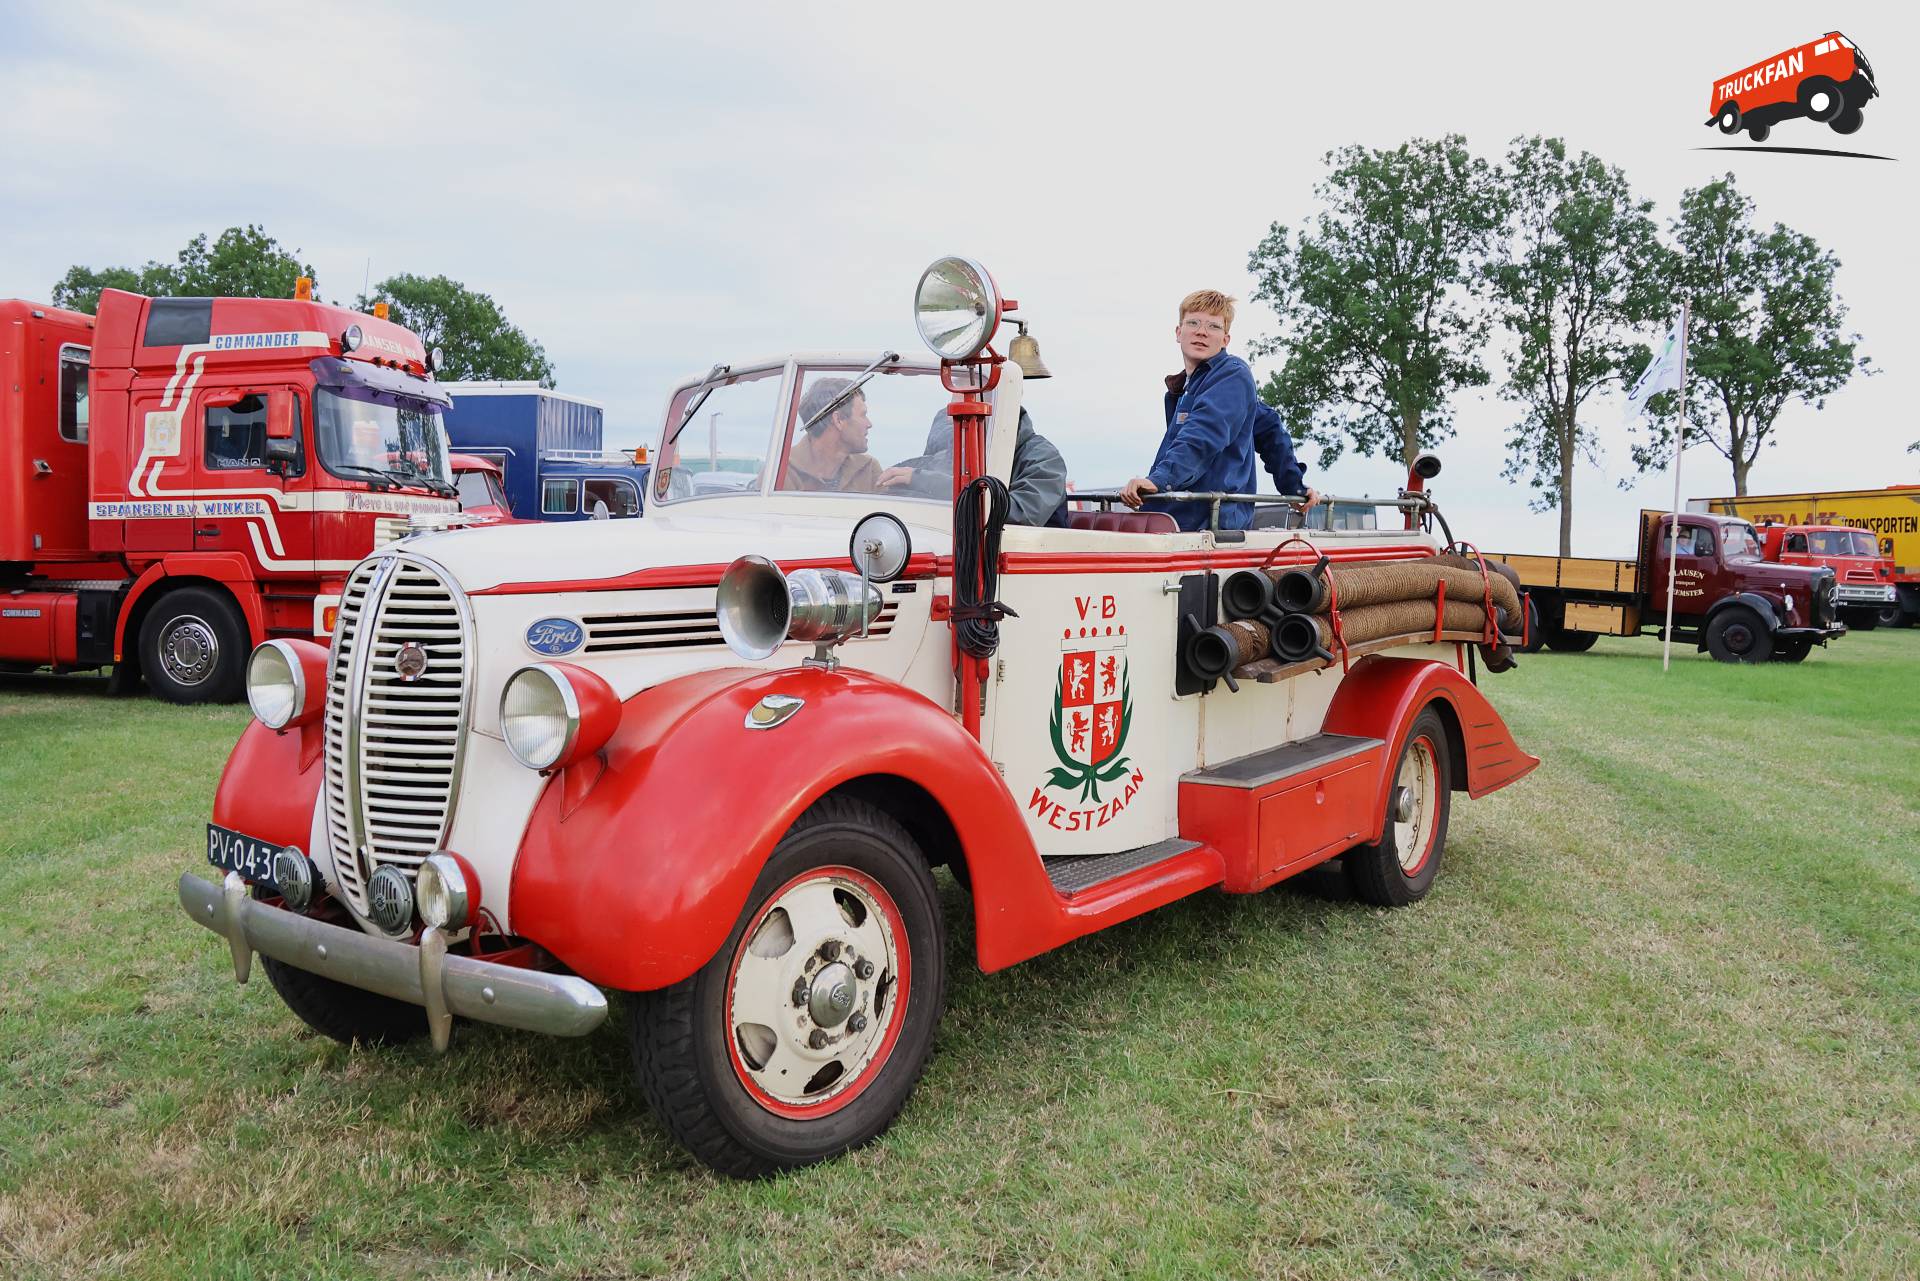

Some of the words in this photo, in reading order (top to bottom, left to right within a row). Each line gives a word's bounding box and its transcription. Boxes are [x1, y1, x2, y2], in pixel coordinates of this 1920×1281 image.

[215, 332, 299, 350] COMMANDER
[96, 503, 173, 517] SPAANSEN
[203, 501, 266, 515] WINKEL
[1074, 594, 1117, 621] V-B
[528, 624, 579, 646] Ford
[1028, 766, 1145, 832] WESTZAAN
